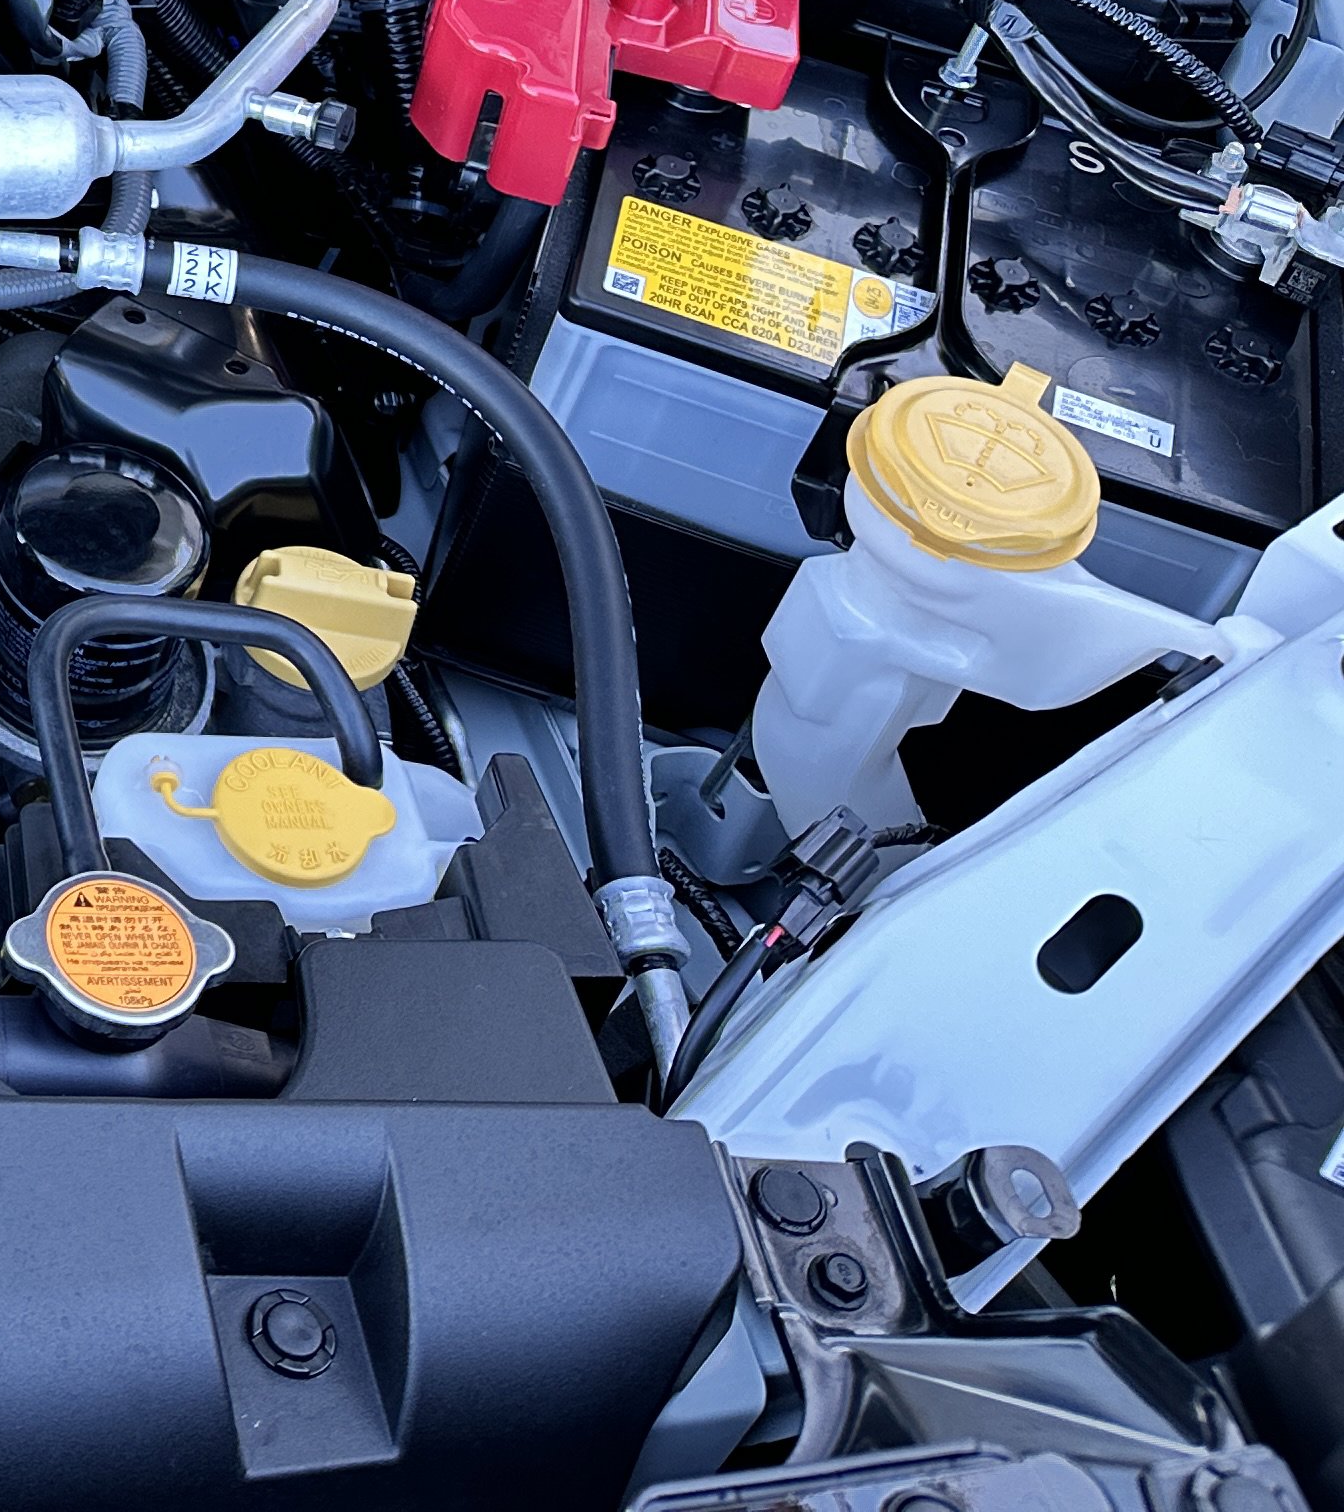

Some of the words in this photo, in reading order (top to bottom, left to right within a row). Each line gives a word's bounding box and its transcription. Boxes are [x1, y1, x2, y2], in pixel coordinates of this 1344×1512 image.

[1068, 140, 1106, 174] S
[628, 201, 692, 228] DANGER
[697, 223, 753, 247] EXPLOSIVE
[755, 242, 791, 259] GASES
[619, 234, 683, 262] POISON
[690, 258, 733, 278] CAUSES
[734, 272, 776, 292] SEVERE
[777, 286, 815, 305] BURNS
[647, 291, 683, 310] 20HR
[683, 302, 716, 321] 62Ah
[720, 314, 751, 332] CCA
[750, 325, 783, 343] 620A
[657, 282, 686, 298] KEEP
[686, 292, 710, 306] OUT
[711, 300, 727, 312] OF
[728, 305, 766, 324] REACH
[766, 318, 783, 330] OF
[782, 323, 839, 349] CHILDREN
[659, 273, 688, 289] KEEP
[688, 283, 718, 299] VENT
[718, 293, 748, 309] CAPS
[750, 303, 781, 319] TIGHT
[782, 314, 805, 327] AND
[806, 322, 842, 341] LEVEL
[1149, 434, 1162, 448] U
[921, 497, 977, 534] PULL
[224, 750, 345, 792] COOLANT
[266, 785, 300, 799] SEE
[264, 814, 333, 830] MANUAL
[93, 895, 150, 905] WARNING
[60, 932, 92, 941] NEVER
[94, 932, 121, 941] OPEN
[124, 933, 154, 941] WHEN
[86, 976, 174, 987] AVERTISSEMENT
